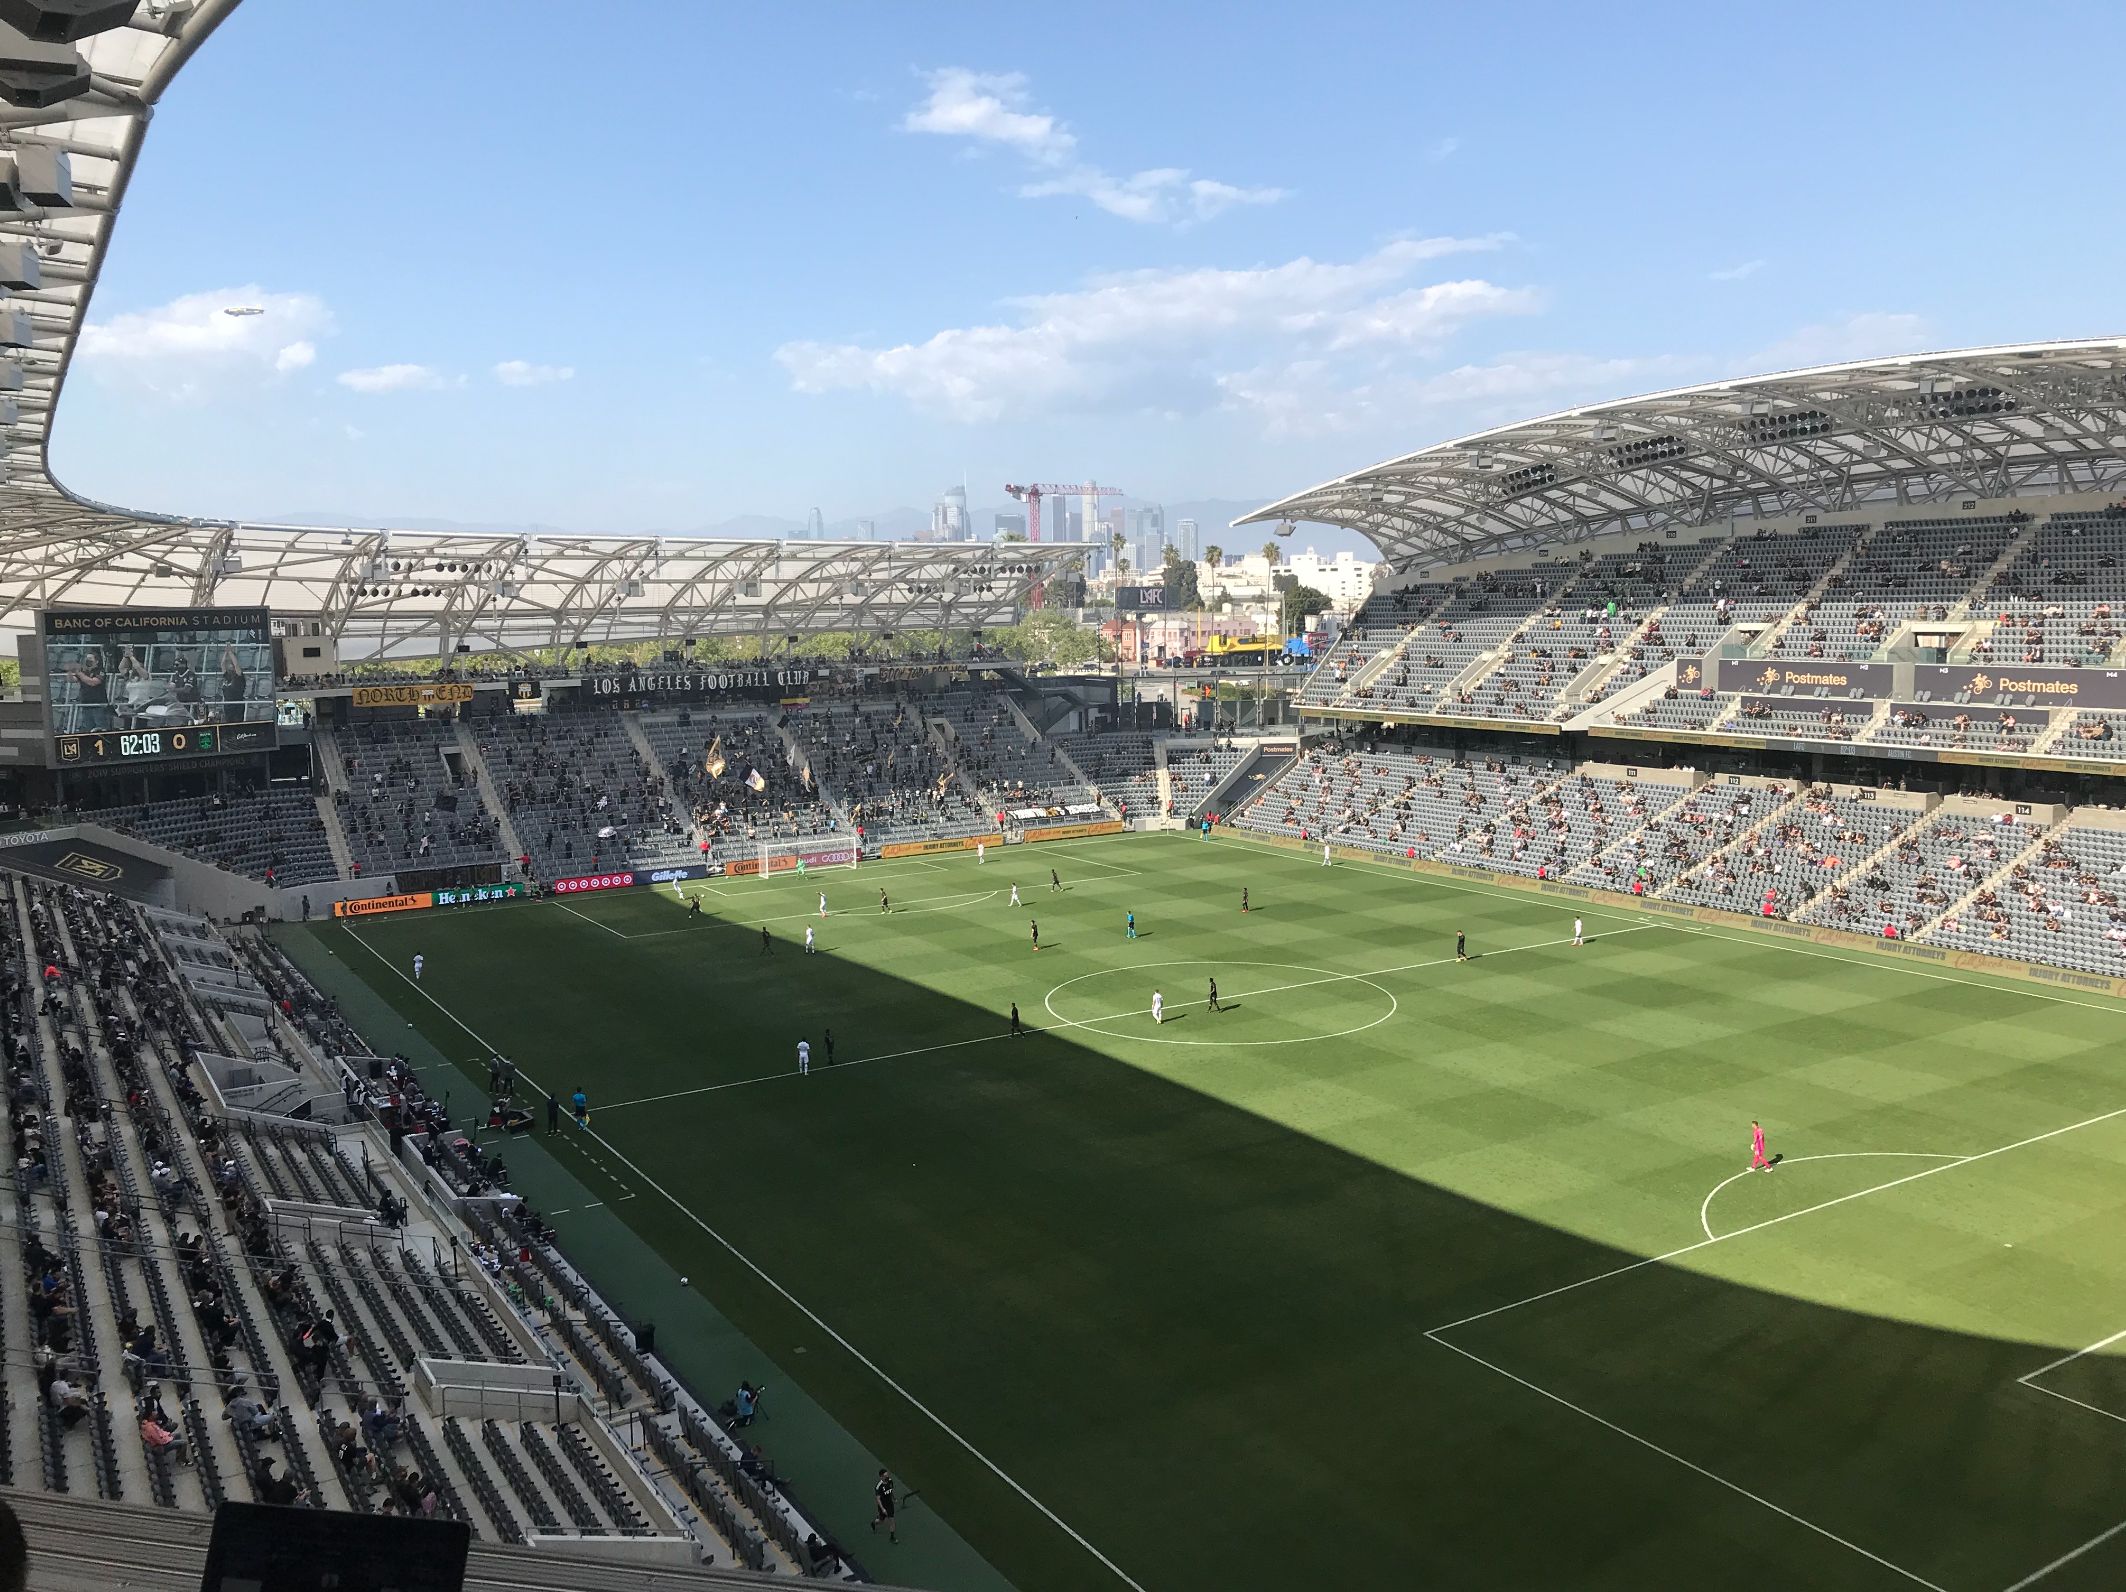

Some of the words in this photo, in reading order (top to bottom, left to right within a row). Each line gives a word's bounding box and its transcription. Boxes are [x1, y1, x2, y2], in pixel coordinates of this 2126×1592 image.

[55, 618, 91, 629] BANC
[94, 617, 112, 628] OF
[115, 616, 188, 627] CALIFORNIA
[192, 615, 260, 626] STADIUM
[594, 678, 621, 695] LOS
[628, 675, 692, 692] ANGELES
[700, 672, 771, 691] FOOTBALL
[777, 670, 810, 686] CLUB
[1785, 671, 1847, 686] Postmates
[1999, 677, 2078, 694] Postmates
[356, 686, 419, 705] NORTH
[434, 685, 473, 701] END
[94, 740, 104, 756] 1
[120, 733, 160, 756] 62:03
[172, 733, 186, 750] 0
[1730, 777, 1739, 785] 112
[1864, 792, 1875, 800] 113
[2017, 806, 2030, 815] 114
[4, 832, 49, 846] TOYOTA
[651, 869, 688, 882] Gillette
[438, 888, 503, 905] Heneken
[350, 896, 409, 914] Continental
[2029, 966, 2061, 981] INJURY
[2060, 972, 2111, 990] ATTORNEYS
